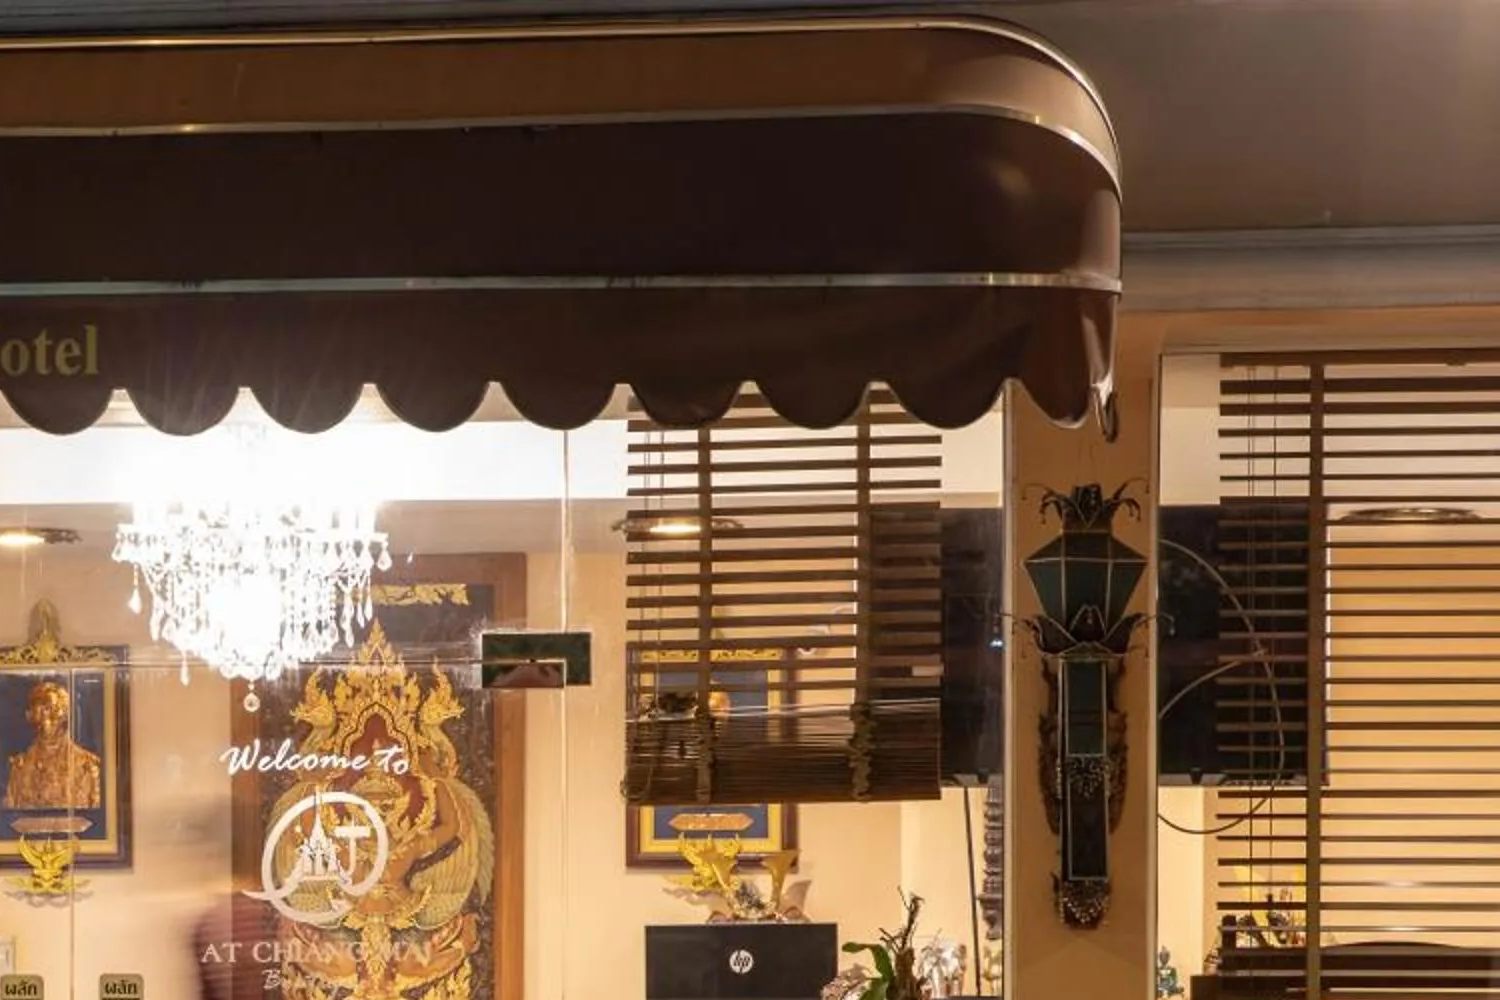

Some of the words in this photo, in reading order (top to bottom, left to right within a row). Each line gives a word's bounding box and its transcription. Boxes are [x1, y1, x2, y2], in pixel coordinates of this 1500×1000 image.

[219, 737, 370, 776] Welcome
[373, 744, 410, 776] to
[201, 942, 243, 963] AT
[729, 949, 754, 974] hp
